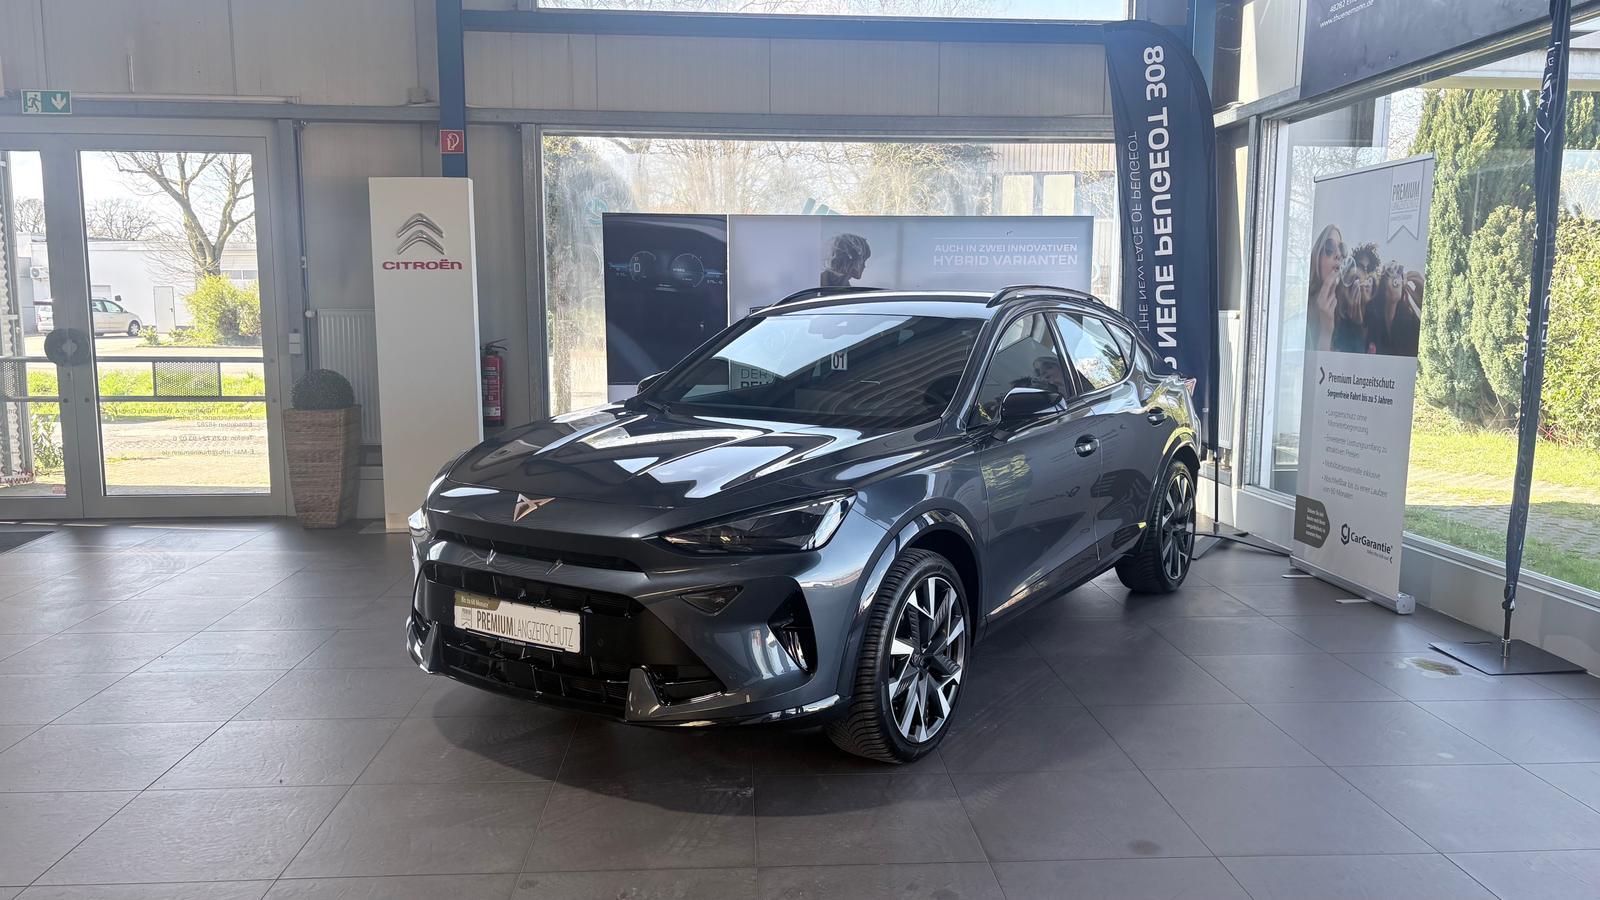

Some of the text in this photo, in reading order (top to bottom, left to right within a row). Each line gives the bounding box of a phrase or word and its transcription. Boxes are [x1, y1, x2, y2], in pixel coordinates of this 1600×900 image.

[934, 243, 1078, 253] AUCH IN ZWEI INNOVATIVEN
[382, 259, 463, 270] CITROËN
[933, 254, 1078, 266] HYBRID VARIANTEN
[1328, 372, 1395, 389] Premium Langzeitschutz
[1350, 392, 1361, 400] Fahrt
[1378, 396, 1393, 405] Jahren
[1351, 531, 1391, 554] CarGarantie
